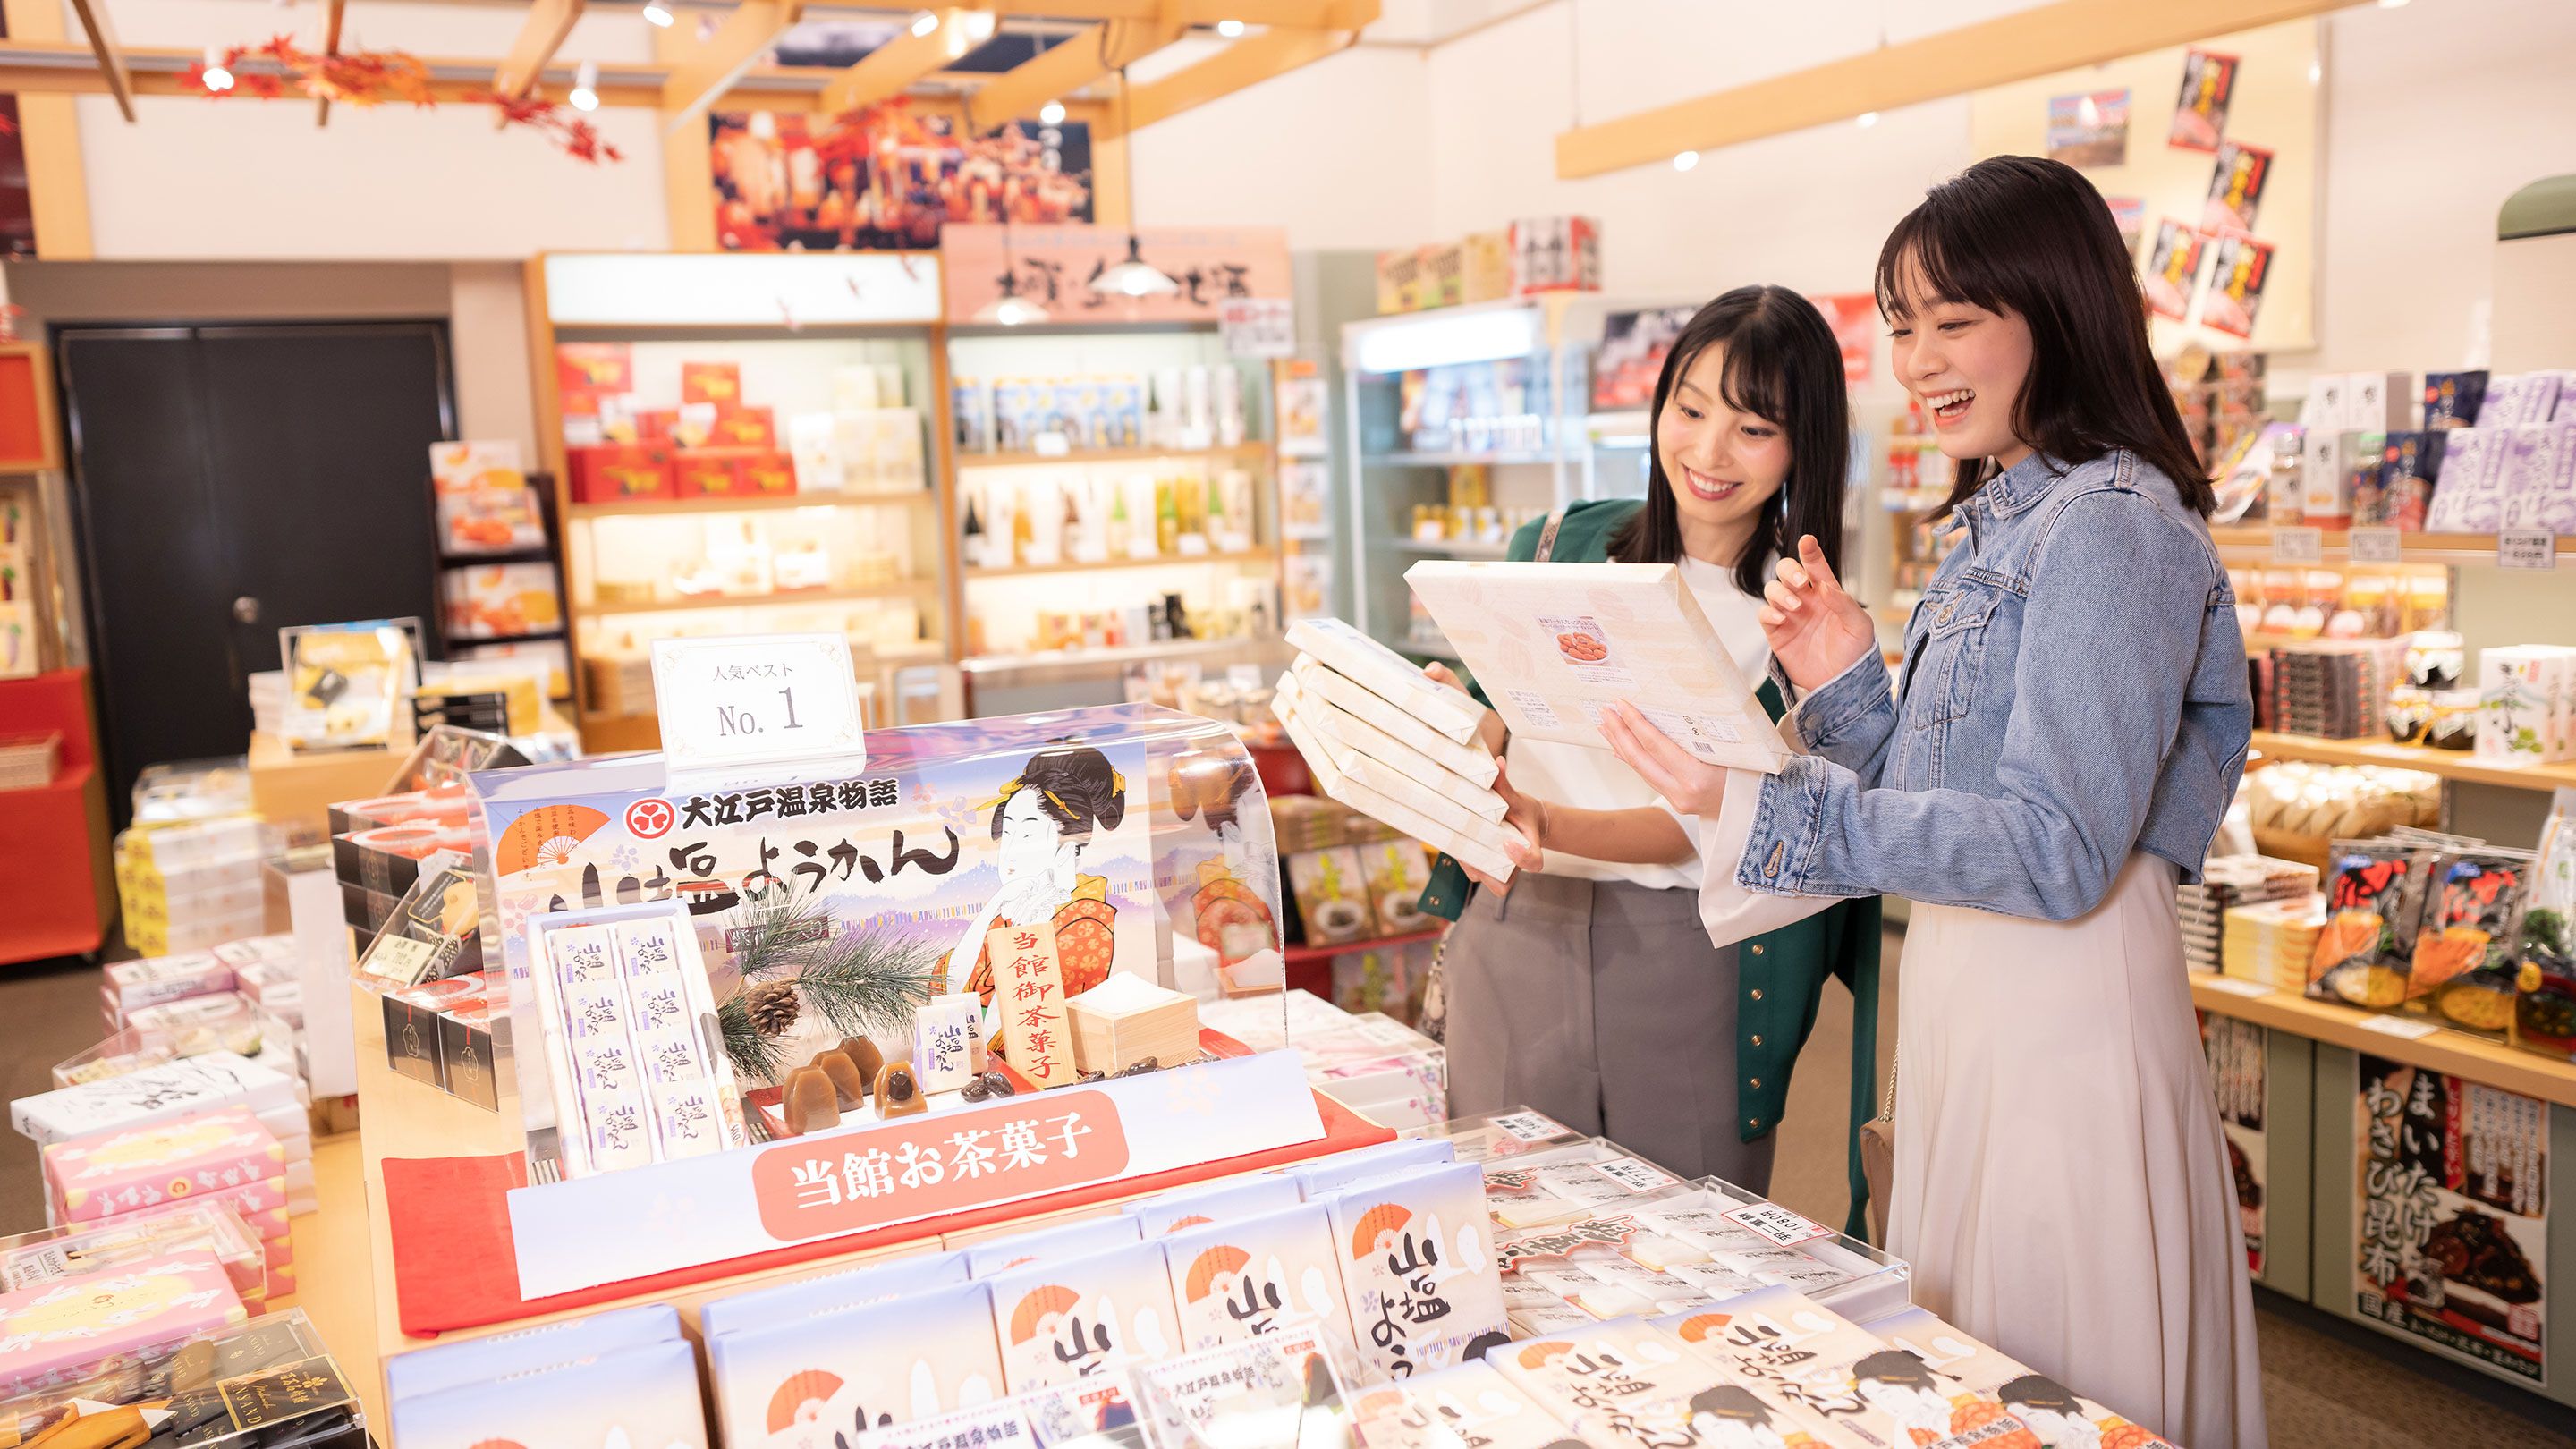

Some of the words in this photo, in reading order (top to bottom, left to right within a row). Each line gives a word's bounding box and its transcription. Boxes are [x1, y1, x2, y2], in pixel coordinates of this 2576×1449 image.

[713, 663, 792, 681] 人気ベスト
[716, 706, 764, 736] No.
[778, 686, 803, 729] 1
[680, 778, 898, 830] 大江戸温泉物語
[572, 950, 595, 983] ようか
[637, 943, 659, 975] ようか
[584, 1004, 599, 1036] ようか
[648, 996, 670, 1029] ようか
[1007, 931, 1062, 1080] 当館御茶菓子
[935, 1032, 954, 1072] ようかん
[944, 1024, 964, 1053] 山塩
[791, 1112, 1093, 1209] 当館お茶菓子
[2361, 1076, 2404, 1287] わさび昆布
[1737, 1212, 1792, 1242] 羽二重餅
[1758, 1209, 1804, 1233] 1080円
[1388, 1232, 1452, 1324] 山塩
